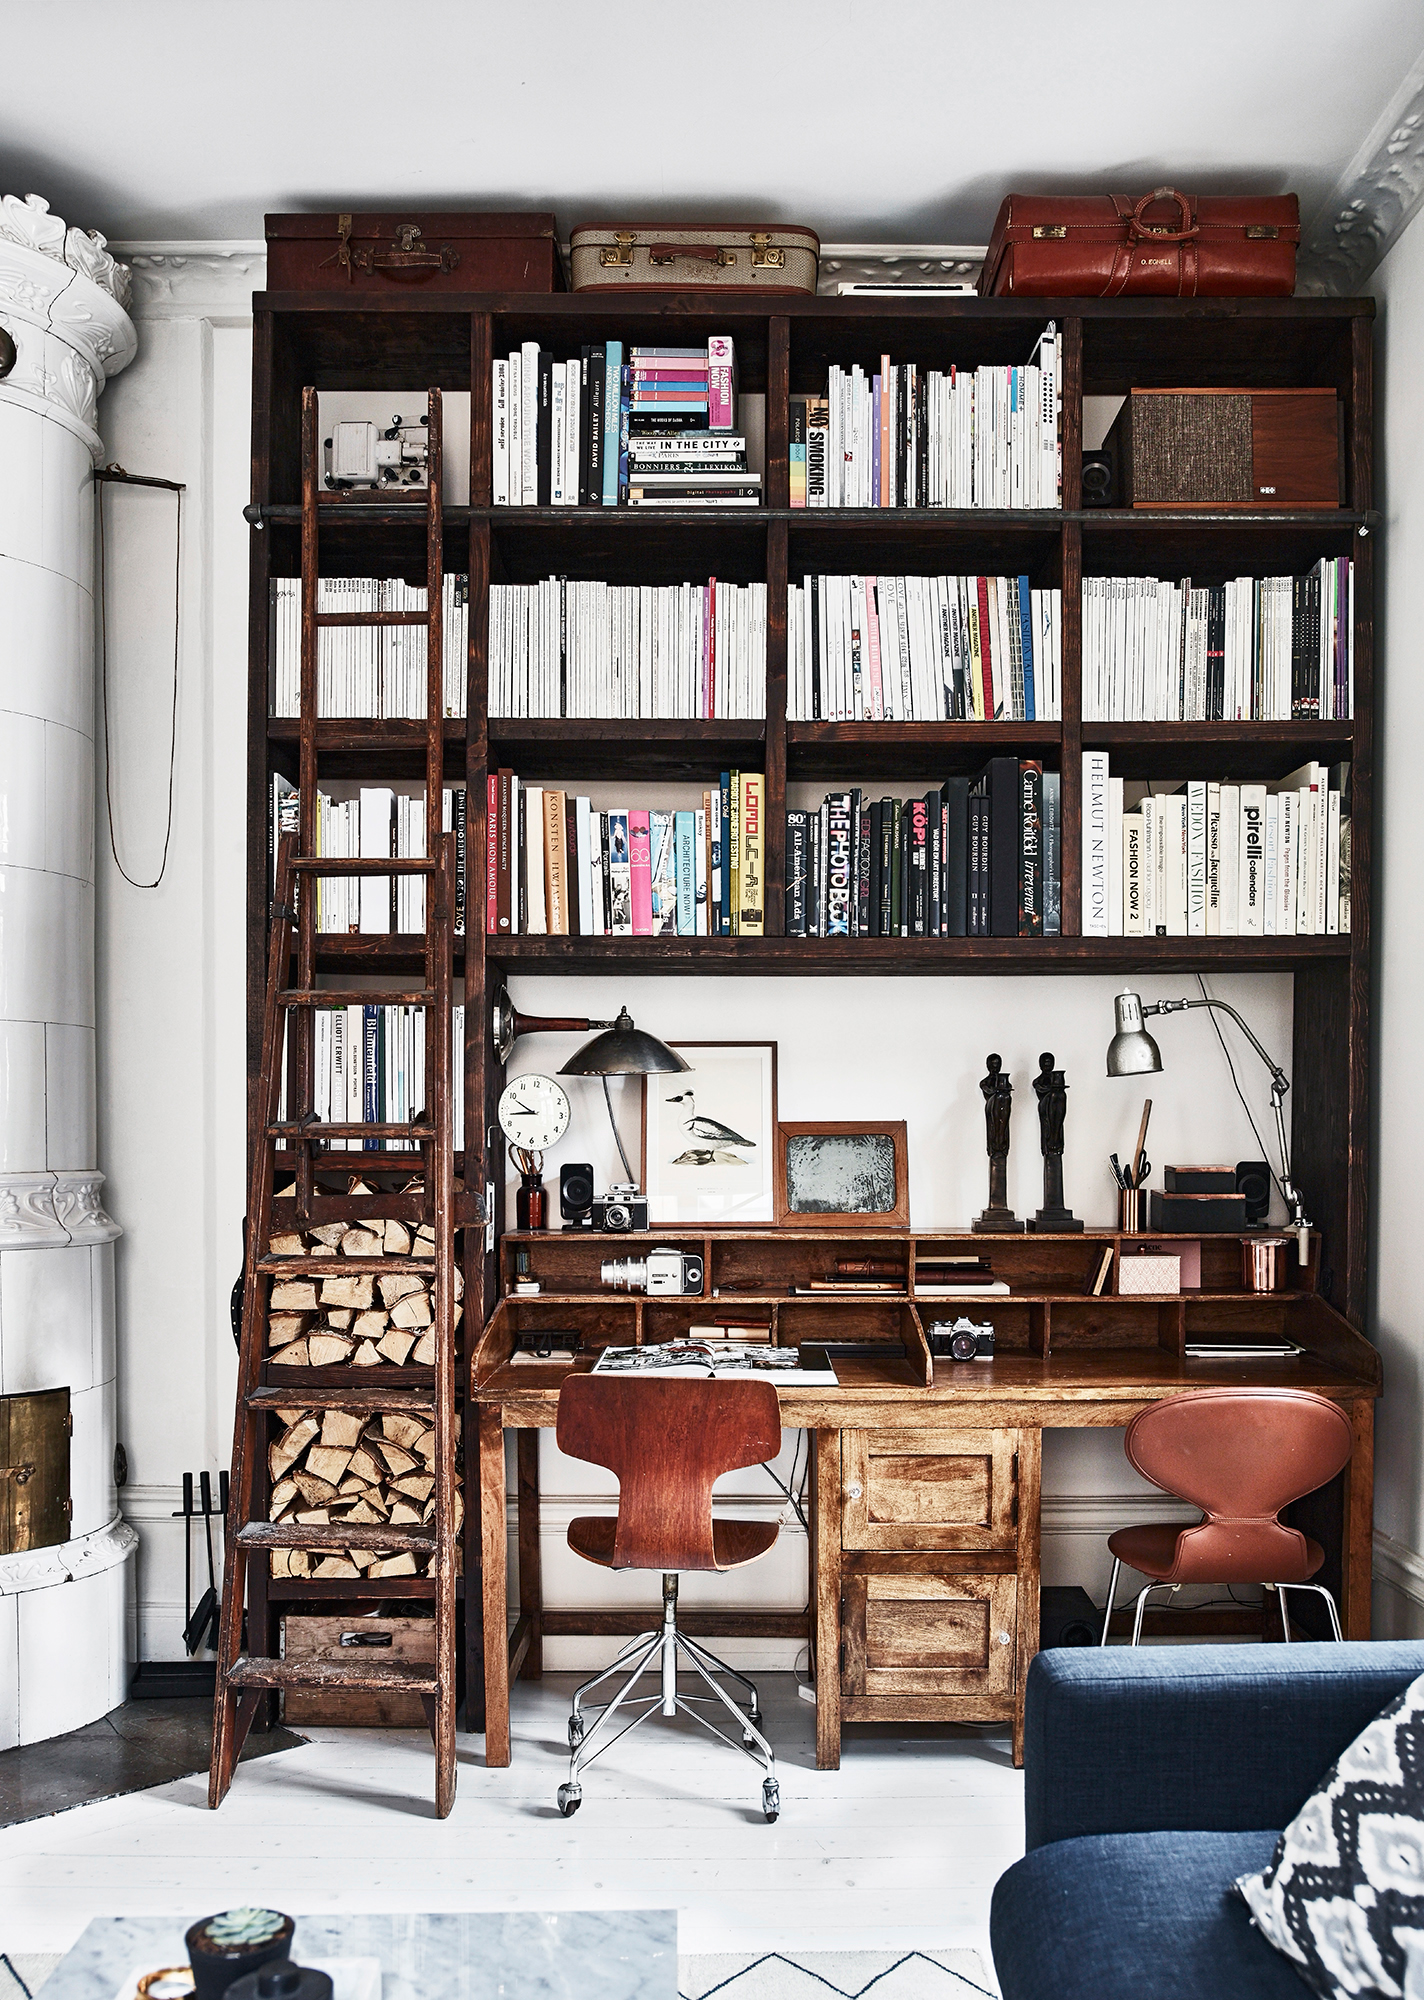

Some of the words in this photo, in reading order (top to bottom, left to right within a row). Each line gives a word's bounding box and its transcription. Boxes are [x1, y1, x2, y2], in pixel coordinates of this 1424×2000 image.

[523, 350, 532, 384] SKIING
[611, 365, 620, 382] TWO
[710, 366, 720, 390] NOW
[611, 383, 620, 412] MILLION
[720, 366, 730, 406] FASHION
[523, 385, 532, 426] AROUND
[611, 412, 620, 433] MILES
[808, 407, 829, 427] NO
[523, 427, 532, 447] THE
[676, 441, 698, 449] THE
[702, 440, 728, 448] CITY
[523, 448, 532, 482] WORLD
[808, 432, 824, 496] SMOKING
[886, 578, 895, 604] LOVE
[1022, 613, 1031, 653] FASHION
[1024, 656, 1033, 682] TALE
[456, 790, 464, 810] ISSUE
[1023, 769, 1038, 810] Carine
[1091, 758, 1104, 832] HELMUT
[550, 795, 559, 852] KONSTEN
[745, 782, 758, 834] LOMO
[828, 795, 850, 829] THE
[912, 802, 928, 846] KÖP!
[1144, 803, 1152, 817] Rico
[456, 812, 464, 858] ANDROGYNY
[861, 818, 870, 838] EDIE
[1023, 812, 1038, 856] Roitfeld
[1144, 818, 1152, 852] Puhlmann
[1210, 812, 1220, 850] Picasso
[1244, 808, 1262, 860] pirelli
[1267, 816, 1277, 852] Resort
[456, 860, 464, 872] THE
[682, 834, 691, 892] ARCHITECTURE
[730, 841, 739, 869] TESTINO
[794, 830, 802, 897] All-American
[861, 838, 870, 880] FACTORY
[932, 852, 939, 860] EN
[1129, 829, 1139, 878] FASHION
[1144, 858, 1152, 884] Fashion
[861, 879, 870, 900] GIRL
[1023, 860, 1038, 915] irreverent
[1091, 839, 1104, 919] NEWTON
[1129, 881, 1139, 910] NOW
[1191, 852, 1204, 914] FASHION
[1208, 858, 1220, 908] Jacqueline
[1249, 860, 1257, 907] calendars
[1267, 856, 1277, 900] Fashion
[794, 900, 802, 920] Ads
[1144, 885, 1152, 908] Legacy
[366, 1018, 377, 1084] Blumenfeld
